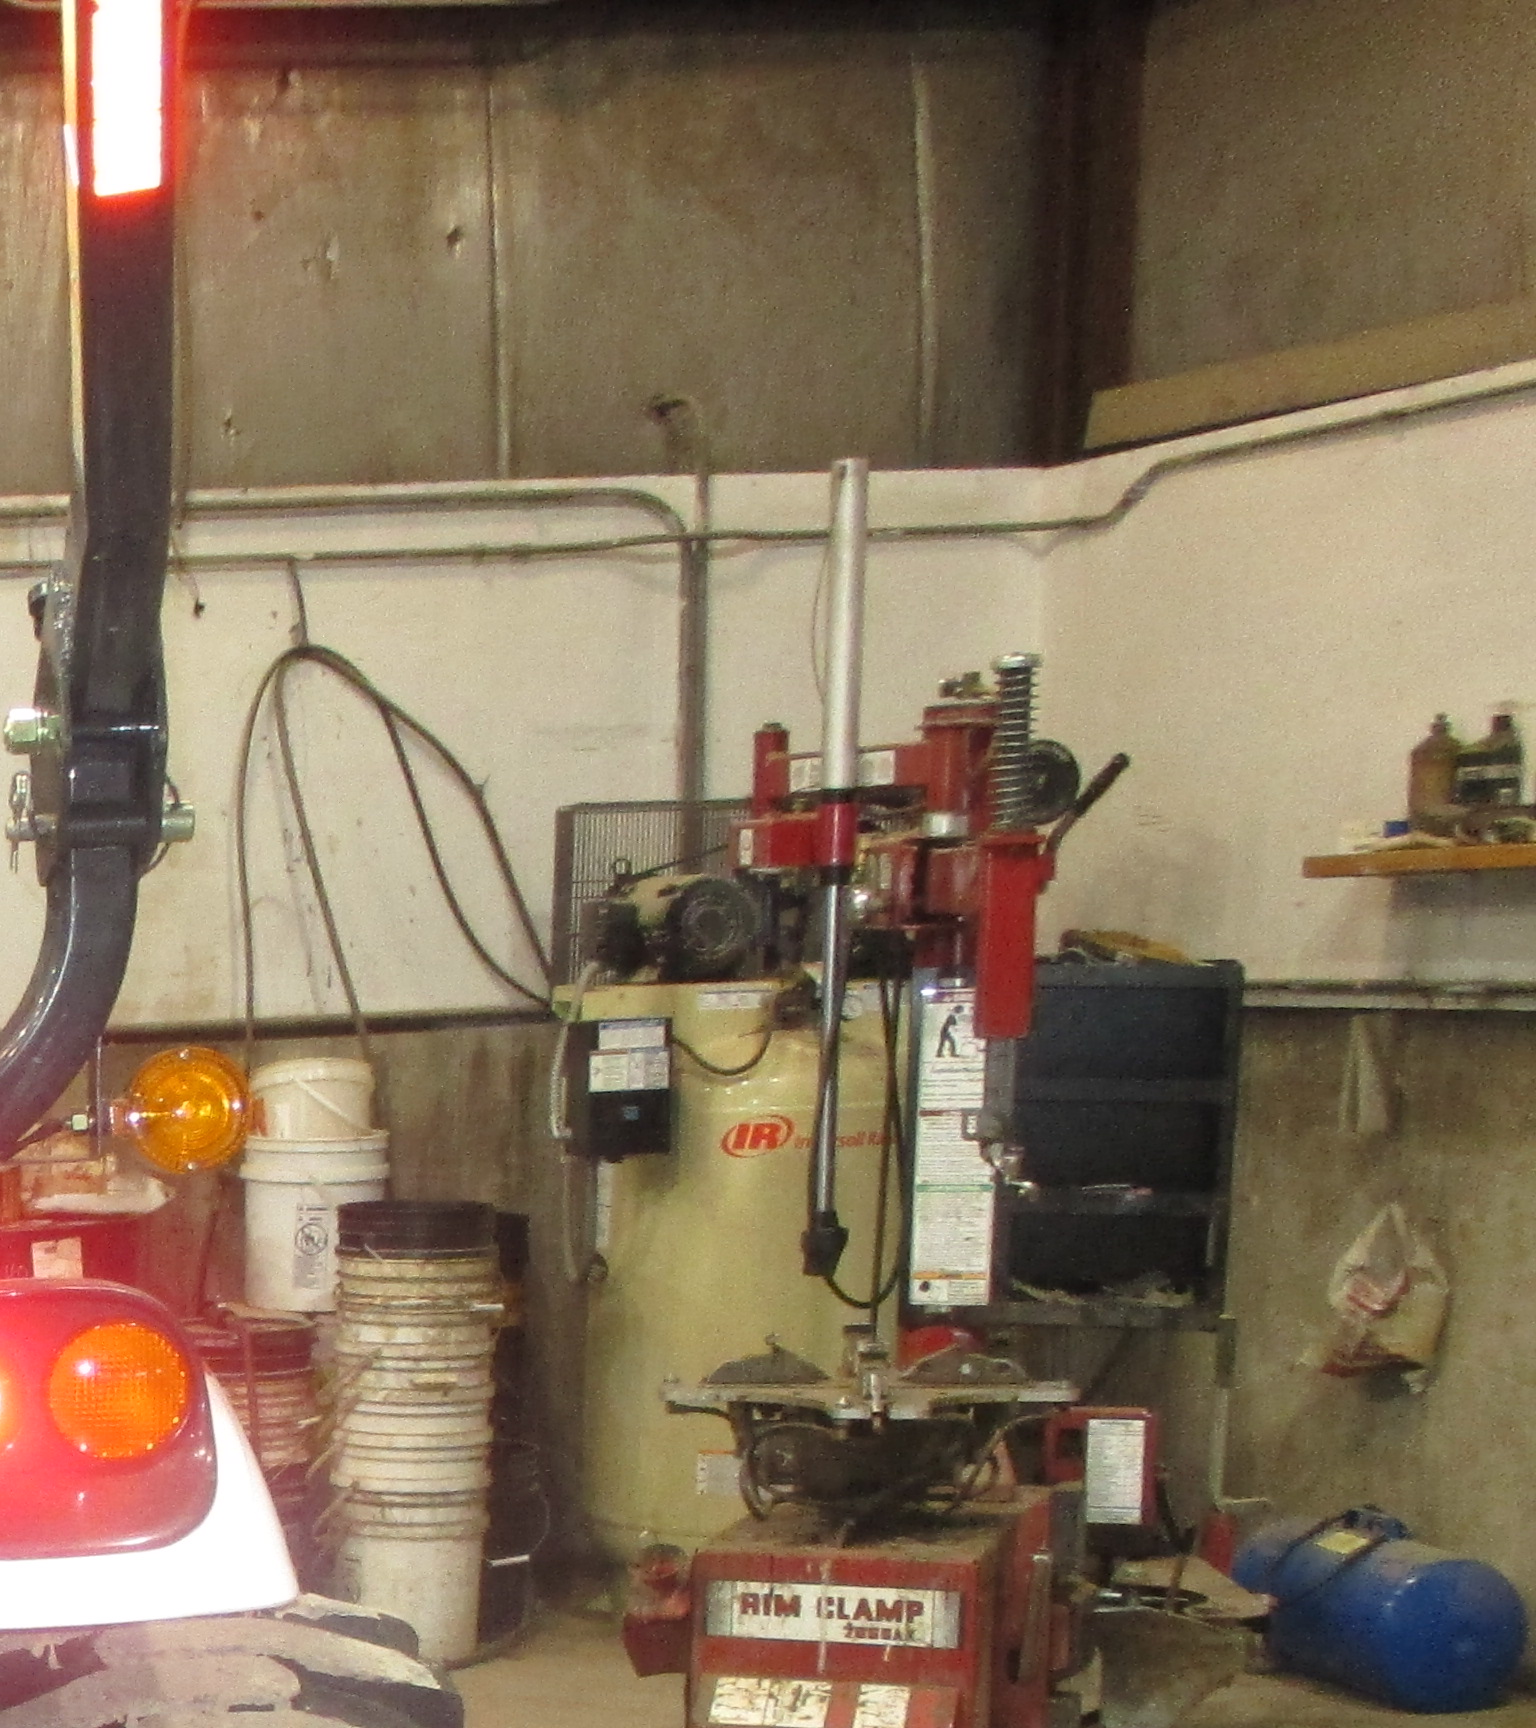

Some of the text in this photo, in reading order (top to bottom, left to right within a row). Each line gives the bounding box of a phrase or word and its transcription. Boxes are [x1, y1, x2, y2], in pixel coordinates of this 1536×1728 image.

[731, 1123, 781, 1150] IR
[740, 1592, 925, 1623] RIM CLAMP
